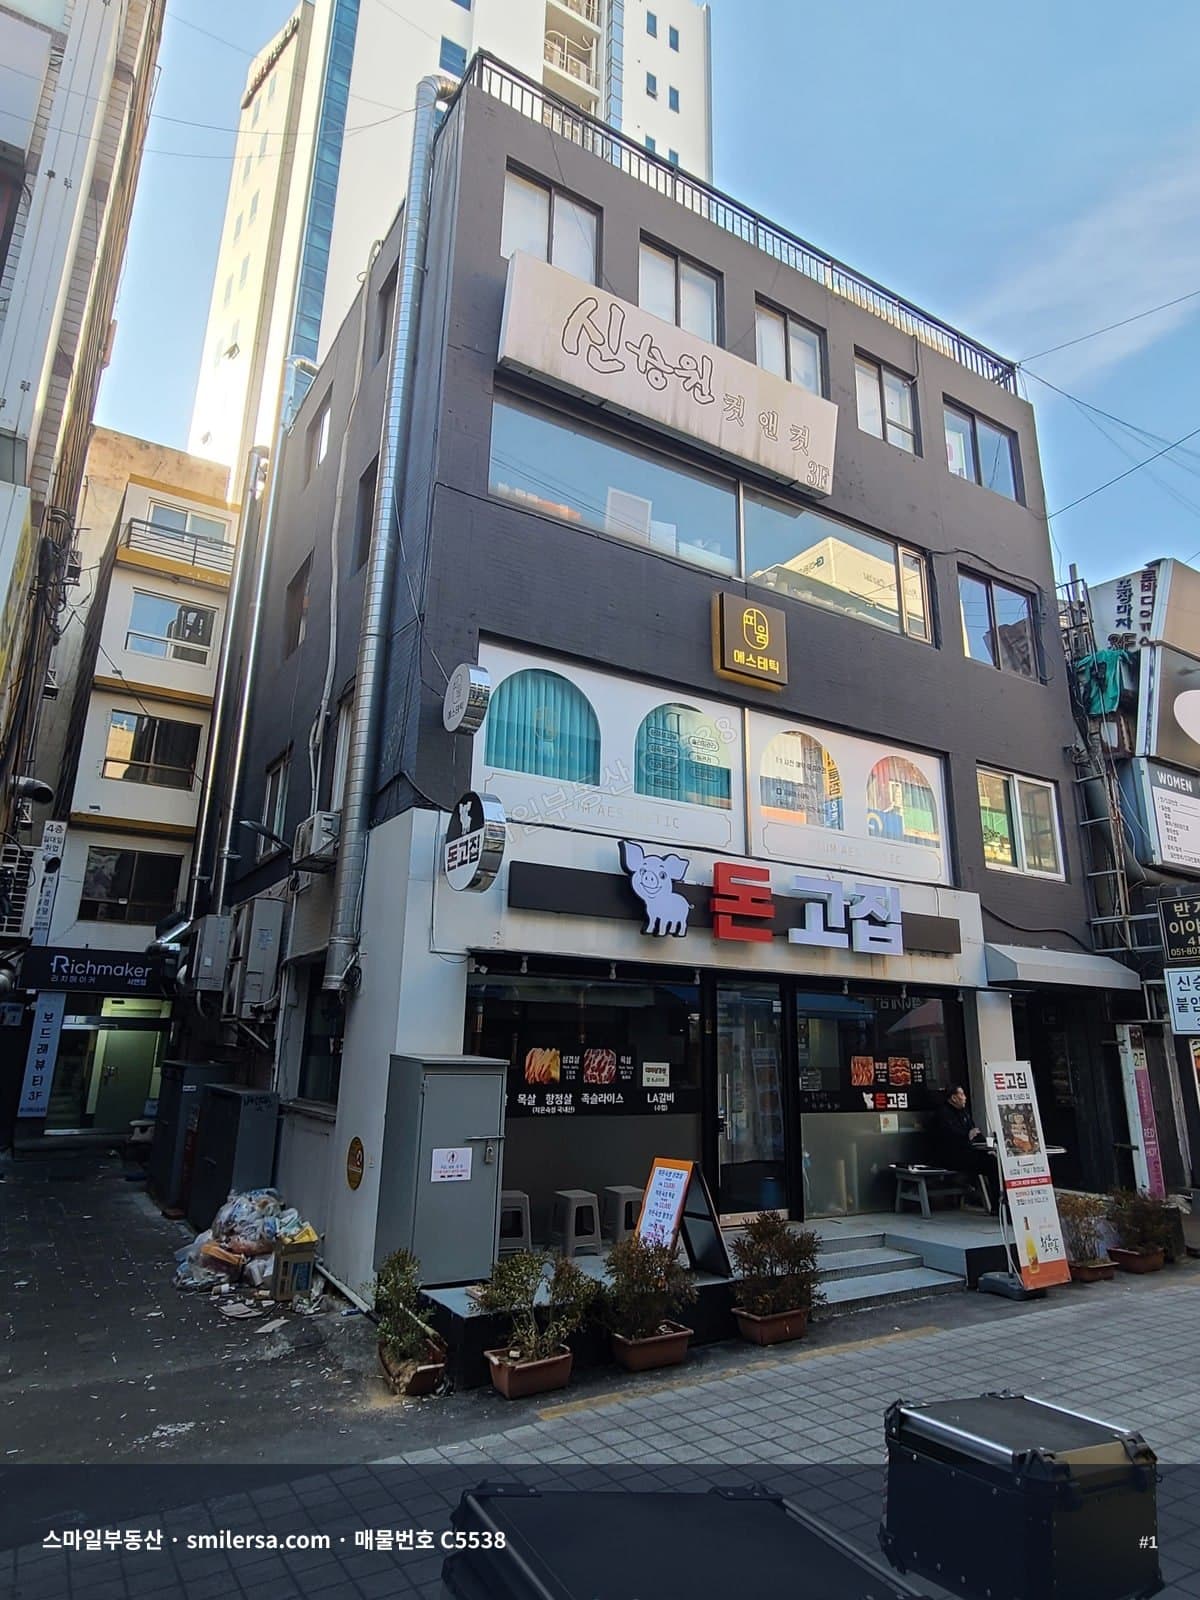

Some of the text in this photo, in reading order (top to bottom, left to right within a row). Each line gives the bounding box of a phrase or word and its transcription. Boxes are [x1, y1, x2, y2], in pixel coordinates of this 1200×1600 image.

[806, 463, 829, 490] 3F
[733, 649, 780, 675] 에스테틱
[1157, 771, 1193, 793] WOMEN
[446, 834, 481, 873] 돈고집
[710, 861, 904, 956] 돈고집
[50, 955, 153, 977] Richmaker
[50, 975, 97, 985] 리치메이커
[1133, 1052, 1145, 1067] 2F
[994, 1072, 1028, 1090] 돈고집
[28, 1091, 44, 1101] 3F
[517, 1093, 537, 1106] 목살
[545, 1092, 573, 1106] 항정살
[647, 1092, 675, 1104] LA갈비
[874, 1092, 908, 1110] 돈고집
